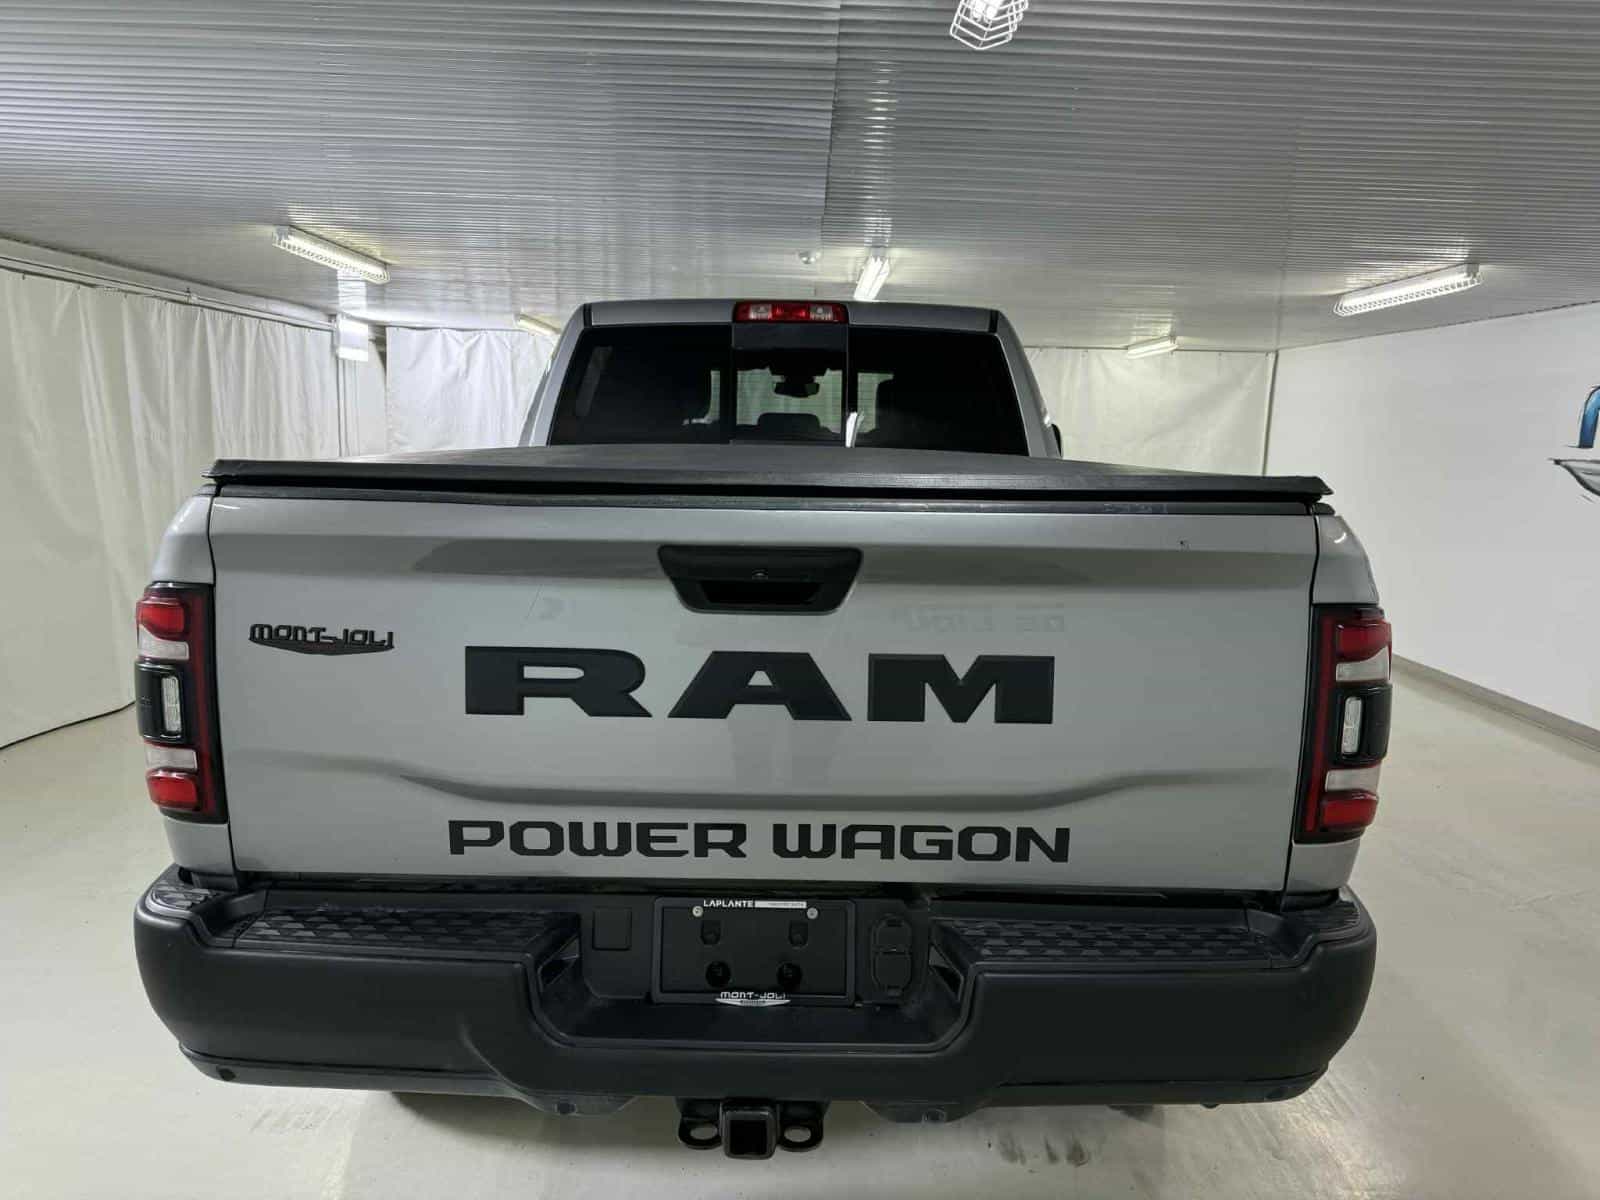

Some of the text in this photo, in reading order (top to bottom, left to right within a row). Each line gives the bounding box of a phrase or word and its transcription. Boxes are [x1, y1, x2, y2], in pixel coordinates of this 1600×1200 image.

[465, 646, 1055, 724] RAM
[448, 820, 1070, 863] POWER WAGON
[703, 899, 754, 908] LAPLANTE
